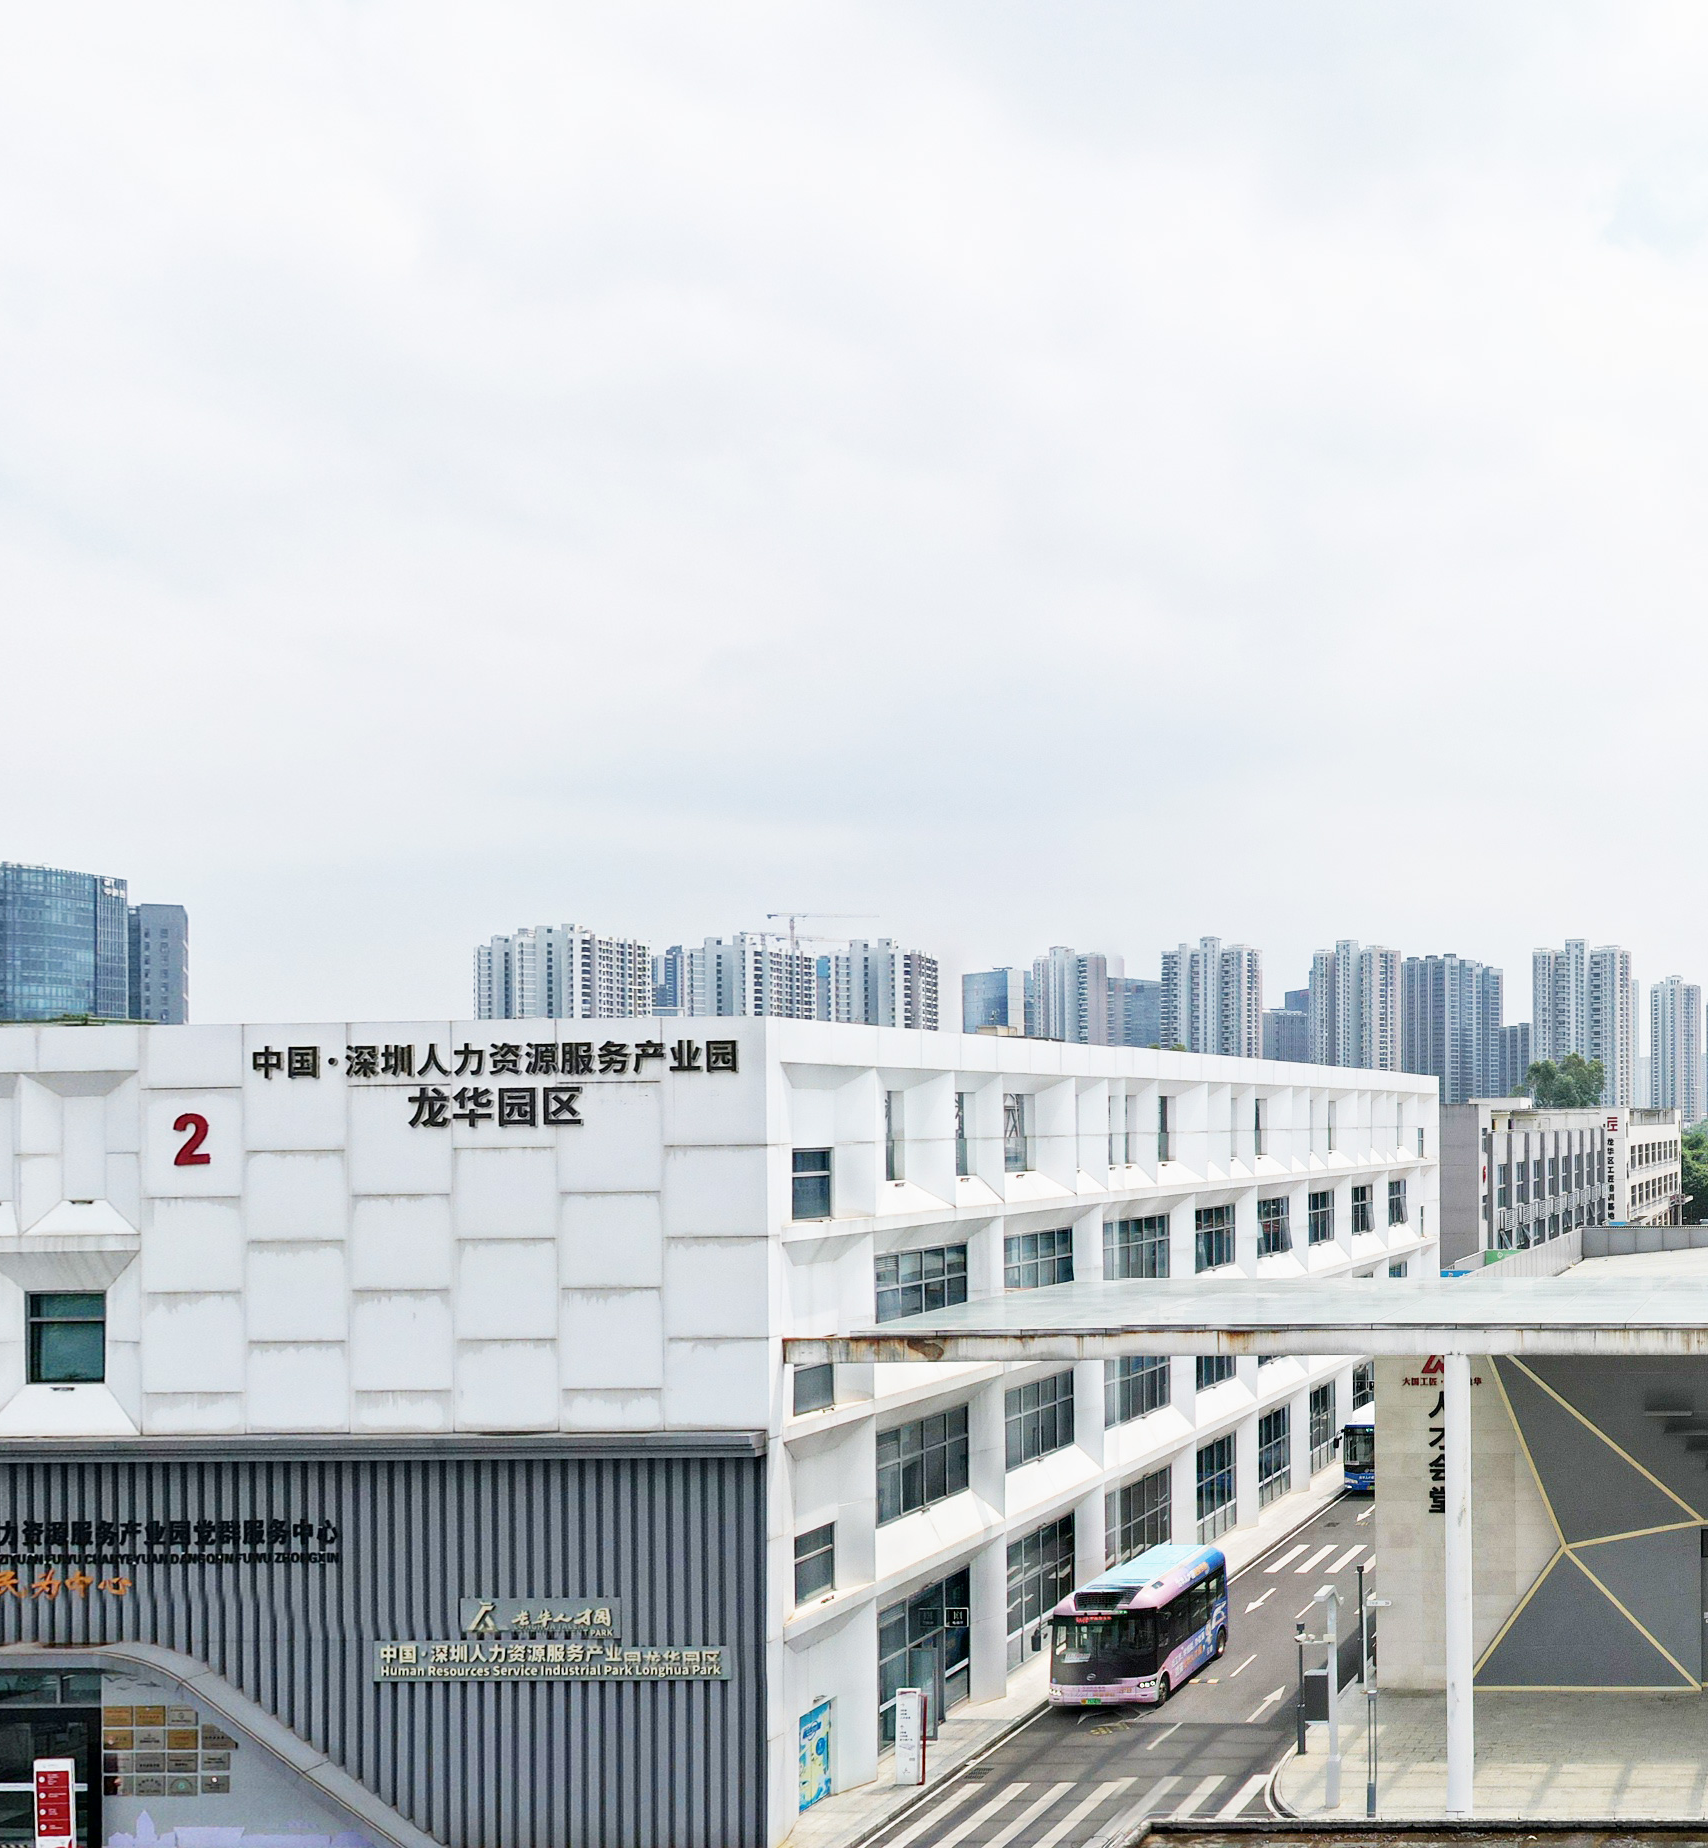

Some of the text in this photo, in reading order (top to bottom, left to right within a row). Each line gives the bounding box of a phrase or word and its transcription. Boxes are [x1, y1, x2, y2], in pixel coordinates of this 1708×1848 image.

[251, 1040, 739, 1079] 中国·深圳人力资源服务产业园
[408, 1086, 584, 1129] 龙华园区
[173, 1112, 212, 1167] 2
[591, 1629, 613, 1637] PARK
[380, 1665, 722, 1678] Human Resources Service Industrial Park Longhua Park
